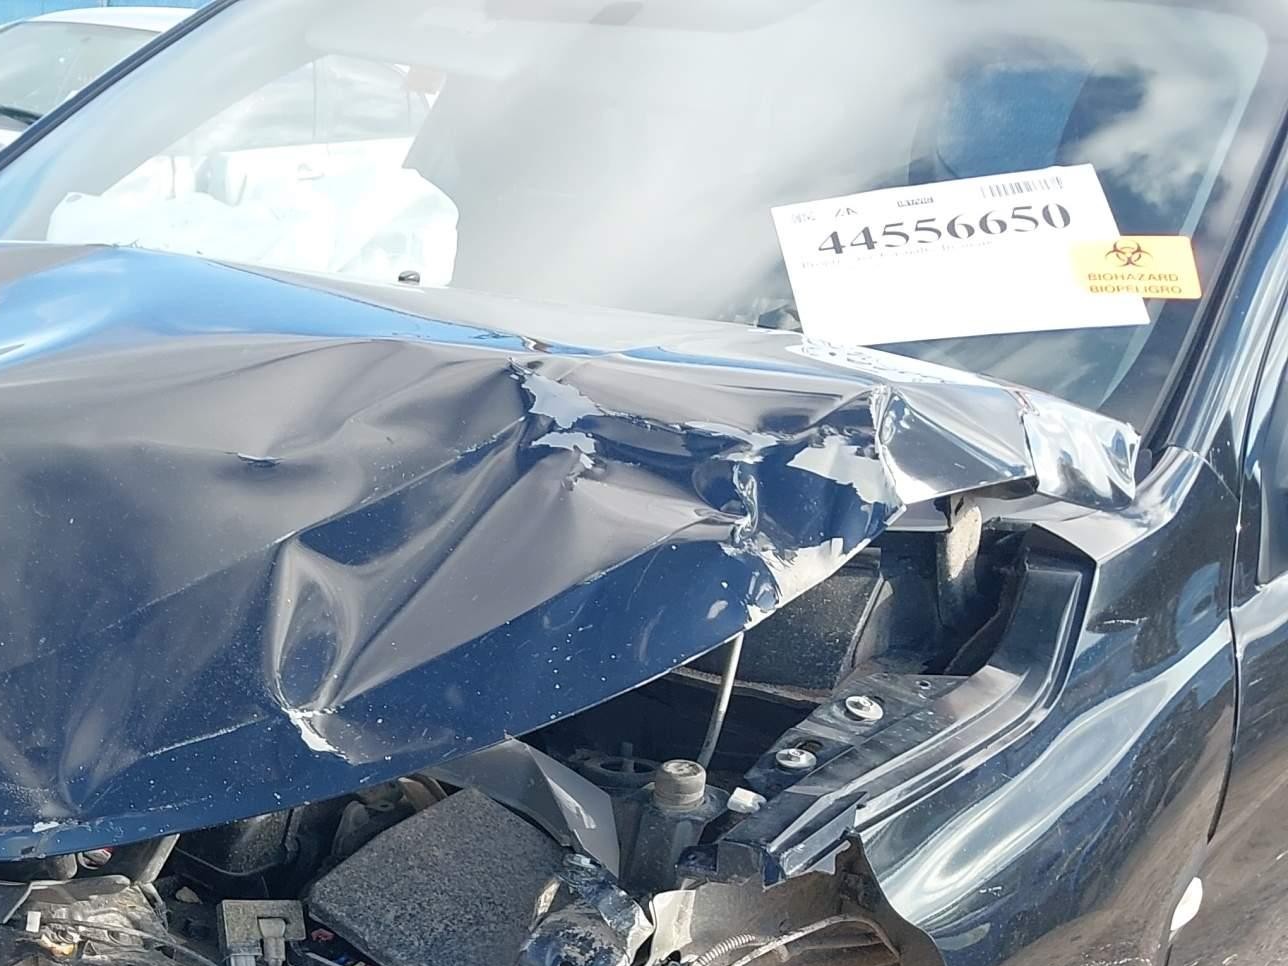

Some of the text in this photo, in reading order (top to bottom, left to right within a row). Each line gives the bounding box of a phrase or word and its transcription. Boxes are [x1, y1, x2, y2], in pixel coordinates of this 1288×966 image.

[818, 202, 1071, 255] 44556650
[1087, 272, 1179, 282] BIOHAZARD
[1089, 284, 1183, 294] BIOPELIGRO
